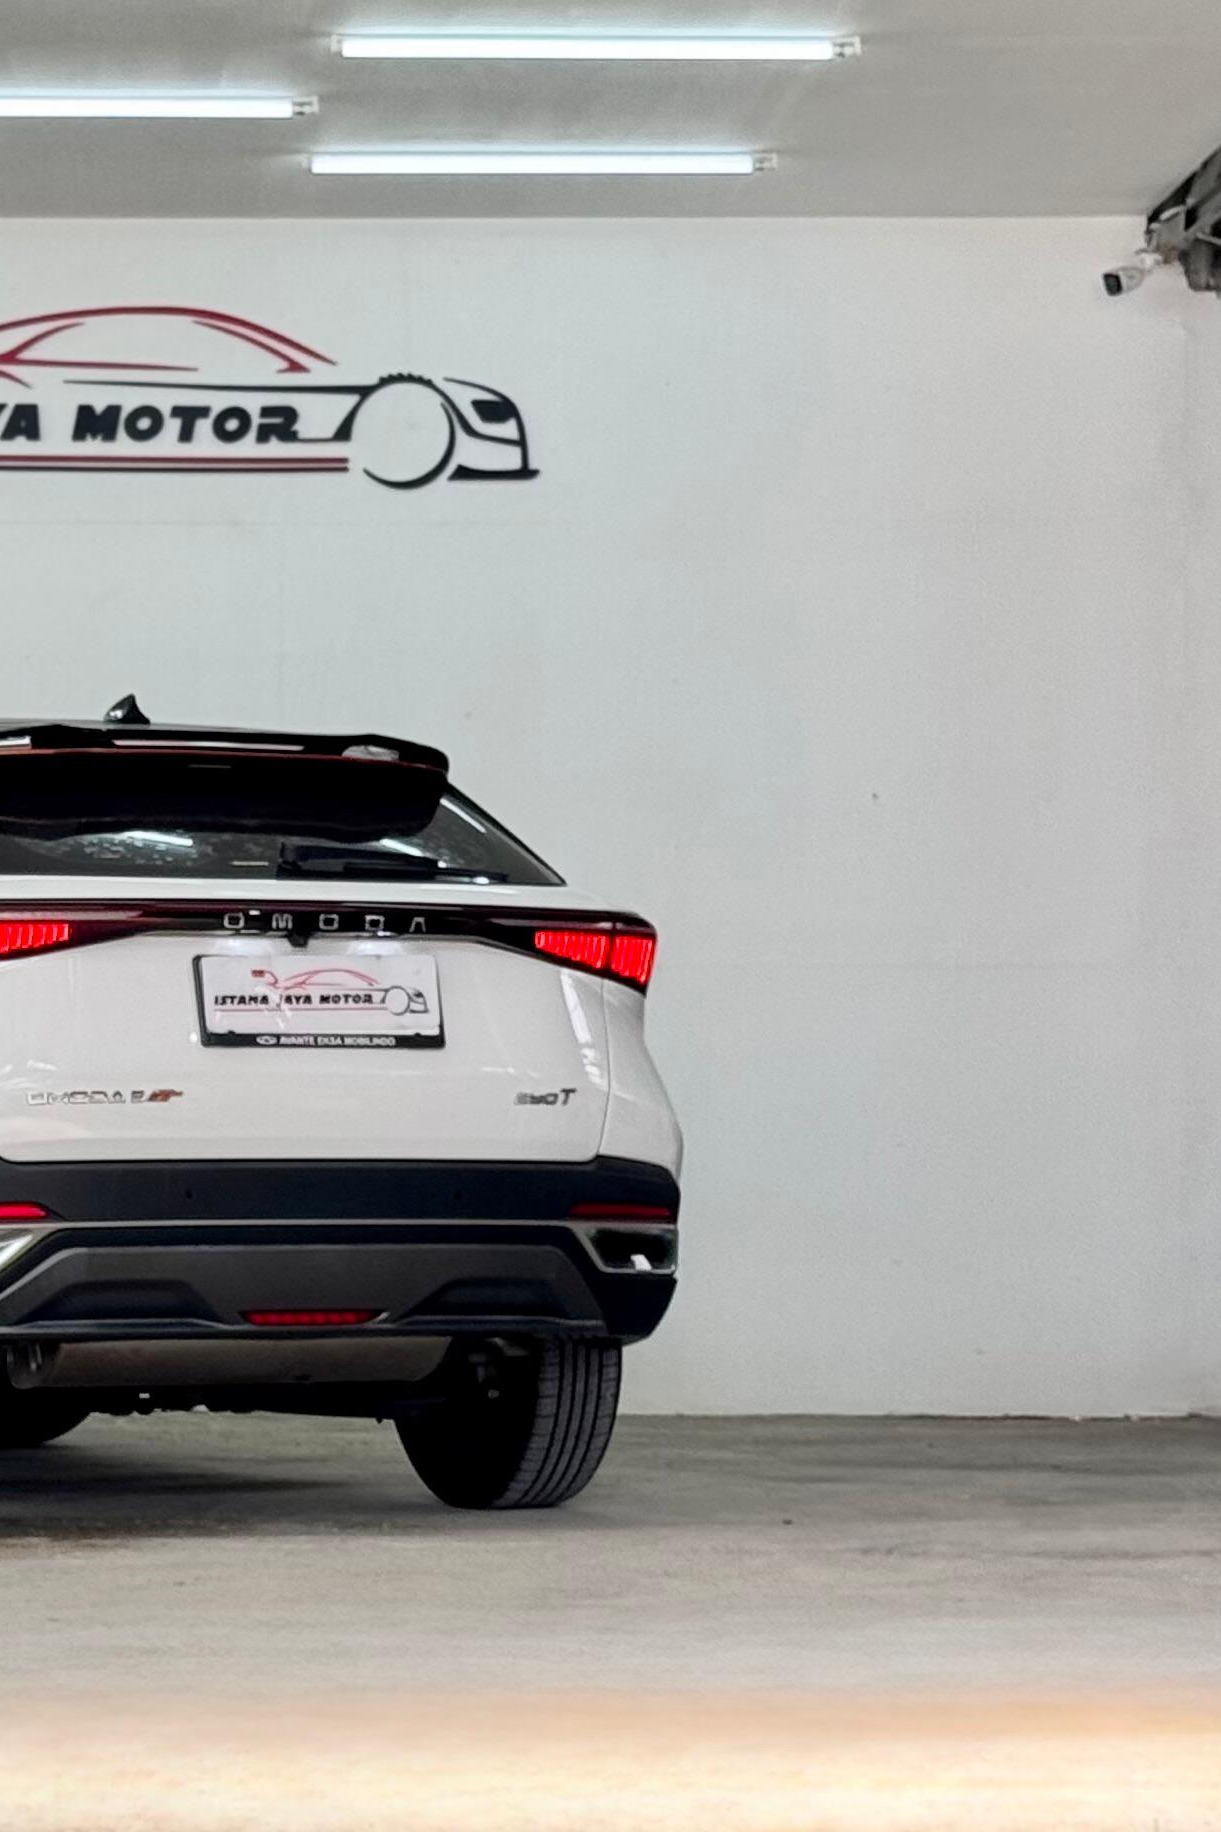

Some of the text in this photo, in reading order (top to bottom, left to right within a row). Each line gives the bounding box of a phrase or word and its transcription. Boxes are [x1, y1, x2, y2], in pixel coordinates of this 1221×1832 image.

[71, 404, 300, 443] MOTOR
[223, 912, 426, 933] OMODA
[214, 994, 269, 1006] ISTANA
[319, 993, 373, 1005] MOTOR
